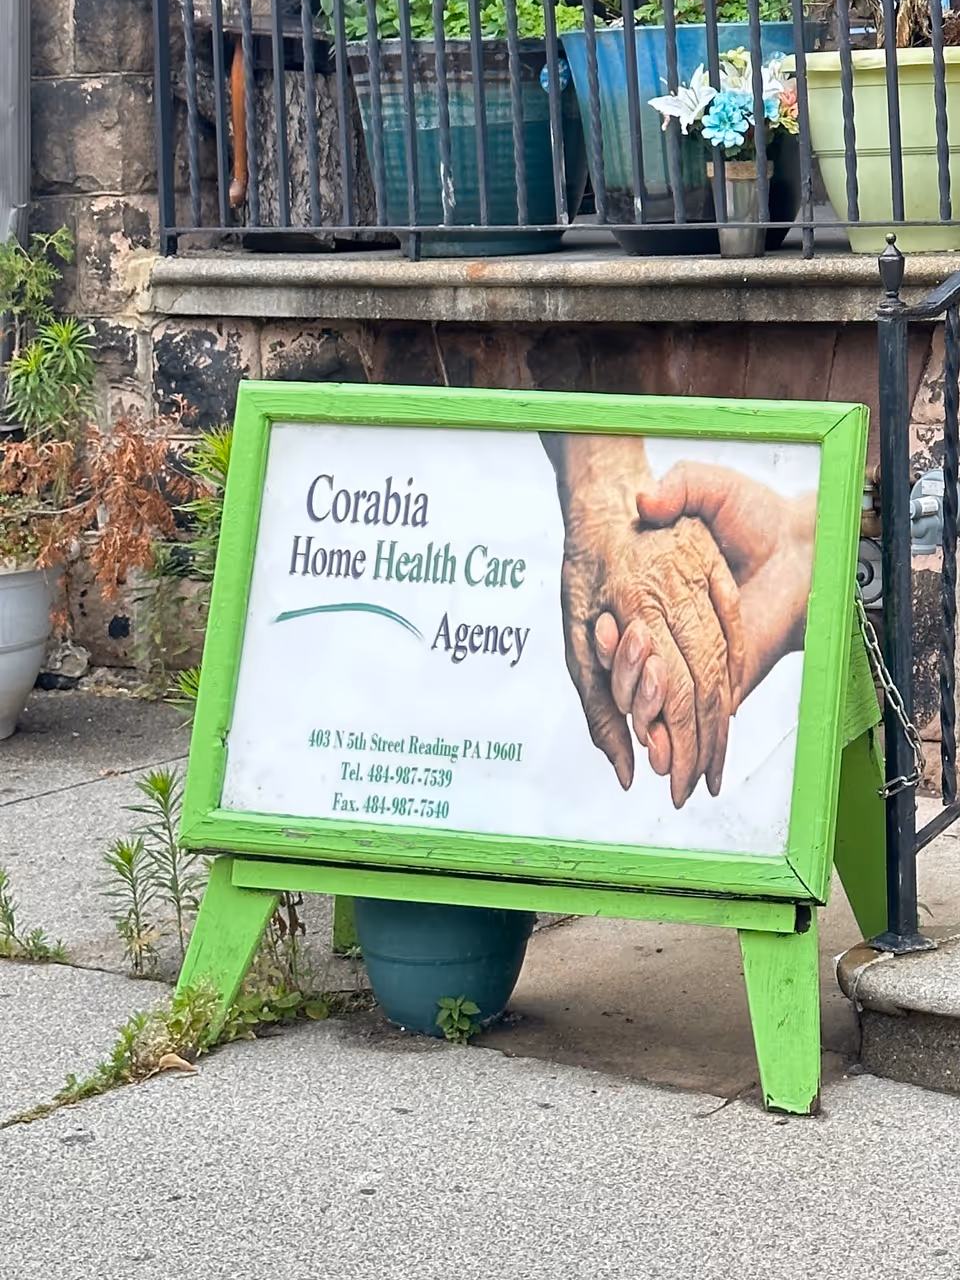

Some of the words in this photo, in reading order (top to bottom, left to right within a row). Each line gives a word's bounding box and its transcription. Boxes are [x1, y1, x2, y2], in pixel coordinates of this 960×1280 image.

[306, 473, 429, 528] Corabia
[289, 535, 366, 579] Home
[372, 539, 457, 584] Health
[464, 544, 526, 589] Care
[431, 611, 531, 668] Agency
[308, 728, 331, 748] 403
[333, 730, 345, 749] N
[347, 731, 366, 751] 5th
[369, 733, 405, 754] Street
[408, 735, 459, 763] Reading
[462, 739, 482, 759] PA
[341, 762, 363, 782] Tel.
[367, 764, 453, 788] 484-987-7539
[332, 792, 359, 812] Fax.
[363, 795, 450, 819] 484-987-7540
